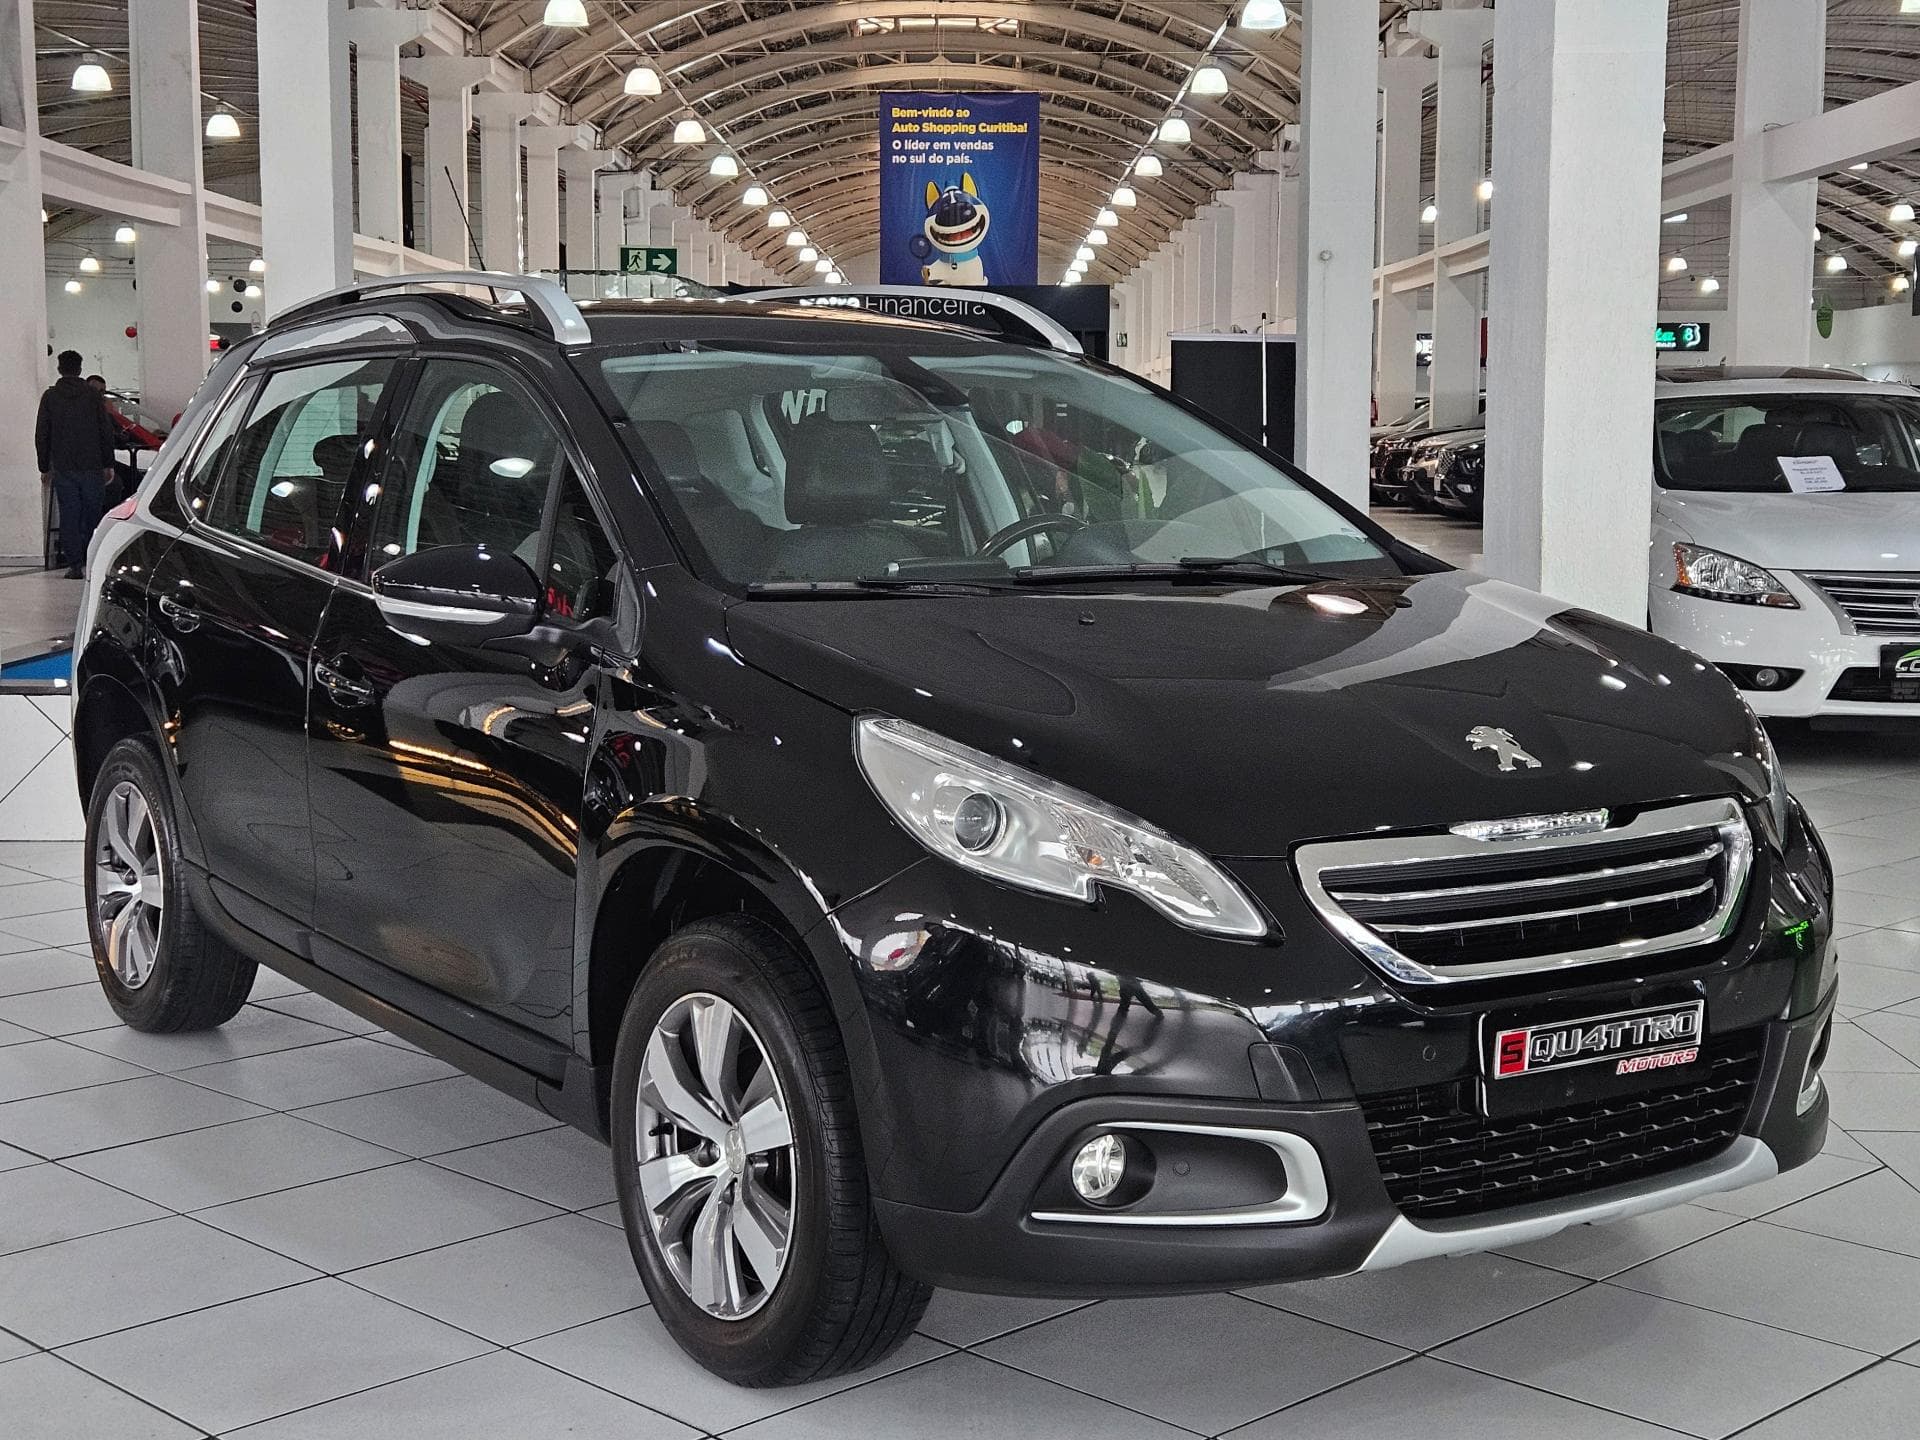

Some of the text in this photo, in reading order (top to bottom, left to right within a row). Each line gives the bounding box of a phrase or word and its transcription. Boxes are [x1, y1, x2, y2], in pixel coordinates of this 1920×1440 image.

[891, 107, 971, 118] Bem-vindo ao
[891, 122, 1028, 134] Auto Shopping Curitiba!
[892, 139, 995, 150] O líder em vendas
[892, 153, 973, 165] no sul do país.
[1615, 1047, 1699, 1075] MOTORS
